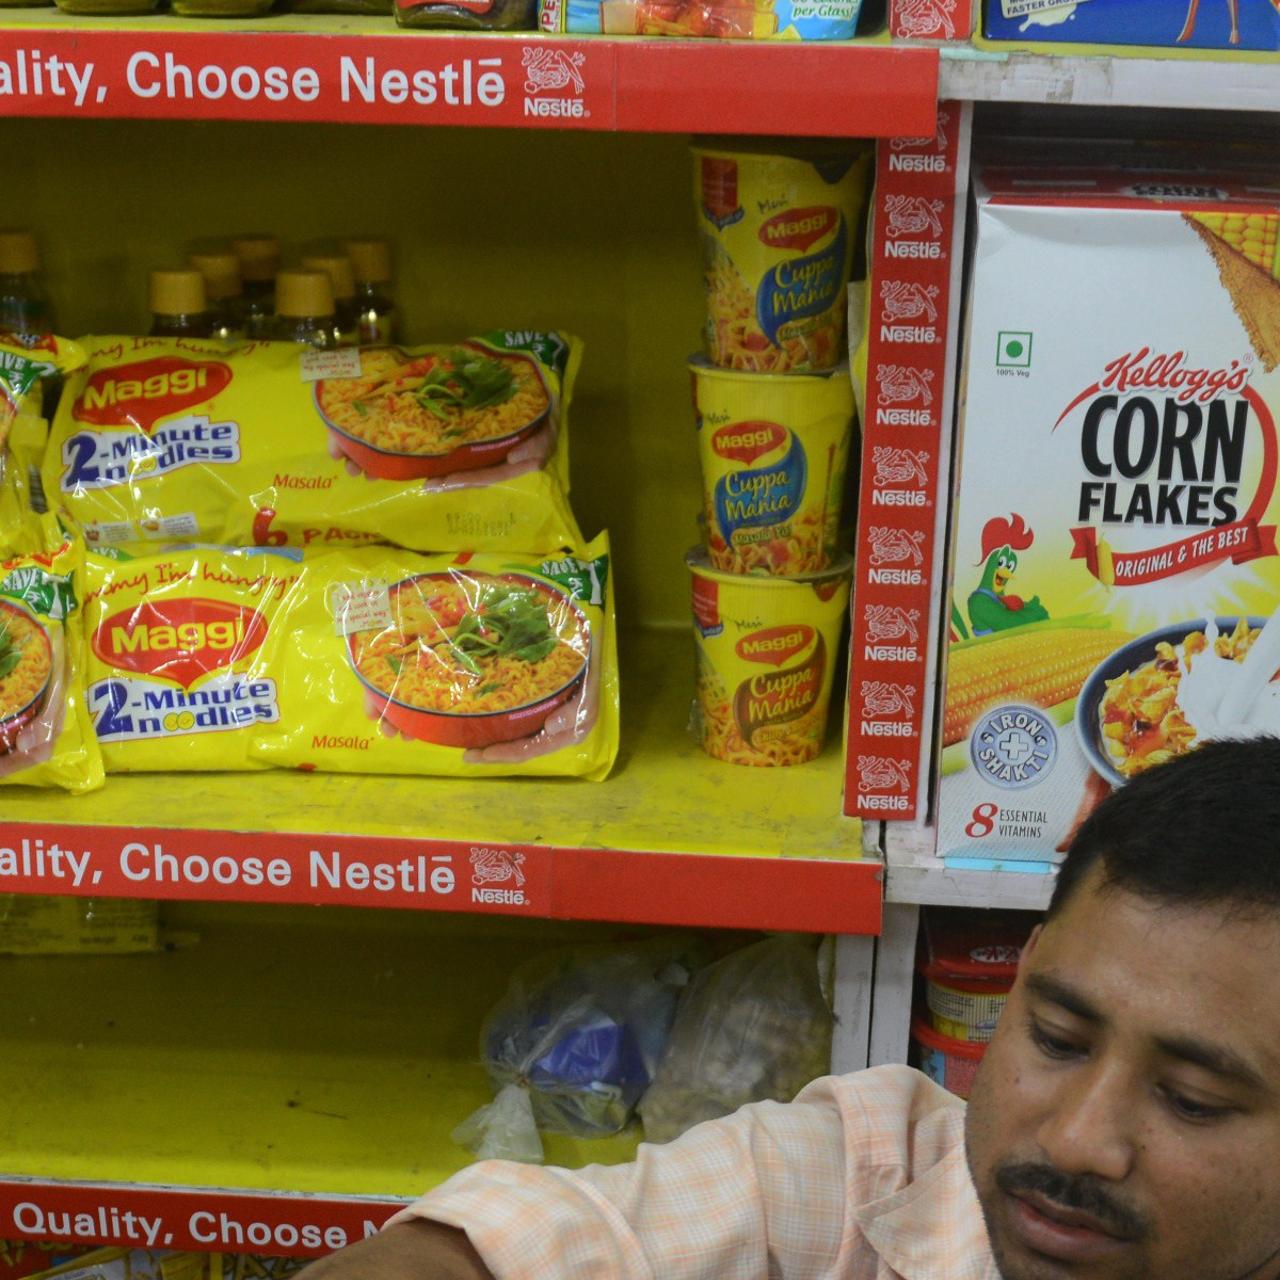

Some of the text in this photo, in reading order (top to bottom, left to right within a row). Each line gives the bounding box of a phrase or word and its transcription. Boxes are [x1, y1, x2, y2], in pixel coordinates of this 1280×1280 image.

[793, 6, 856, 19] per Glass!
[126, 51, 320, 100] Choose
[767, 210, 829, 240] Maggi
[505, 329, 544, 348] SAVE
[82, 365, 209, 412] Maggi
[1096, 346, 1250, 402] Kellogg's
[716, 427, 774, 450] Maggi
[1080, 394, 1250, 484] CORN
[272, 472, 338, 491] Masala
[724, 468, 790, 498] Cuppa
[725, 495, 792, 521] Mania
[1077, 480, 1239, 529] FLAKES
[252, 505, 277, 547] 6
[1115, 525, 1250, 578] ORIGINAL & THE BEST
[109, 616, 245, 655] Maggi
[741, 630, 805, 657] Maggi
[749, 666, 815, 698] Cuppa
[90, 677, 271, 740] 2-Minute
[747, 692, 814, 723] Mania
[311, 732, 375, 751] Masala
[989, 709, 1041, 742] IRON
[978, 747, 1050, 783] SHAKTI
[964, 802, 998, 839] 8
[998, 824, 1042, 839] VITAMINS
[999, 808, 1049, 825] ESSENTIAL
[119, 842, 293, 887] Choose
[12, 1200, 174, 1245] Quality,
[188, 1210, 349, 1250] Choose
